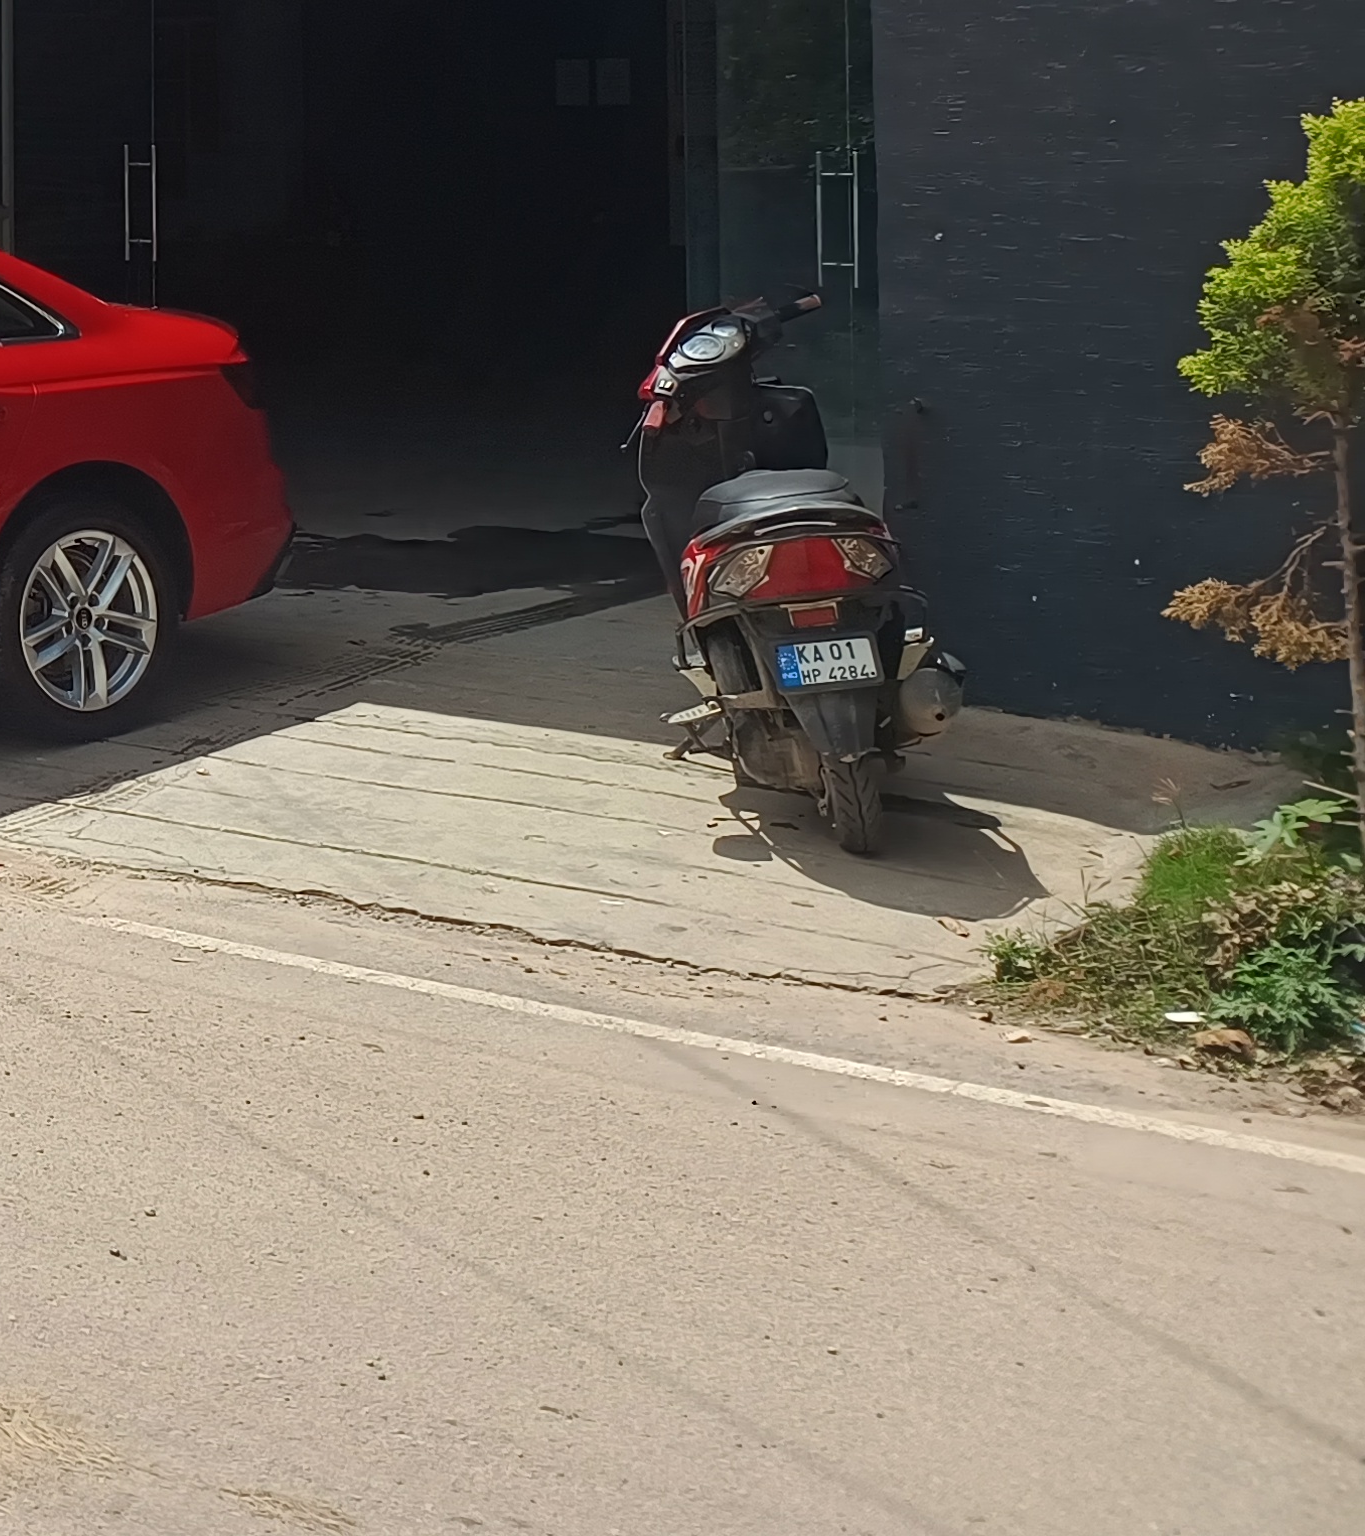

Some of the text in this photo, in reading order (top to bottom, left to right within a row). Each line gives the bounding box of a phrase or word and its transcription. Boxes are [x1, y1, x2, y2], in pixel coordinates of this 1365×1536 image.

[795, 641, 856, 664] KA 01
[801, 668, 822, 684] HP
[829, 664, 869, 681] 4284
